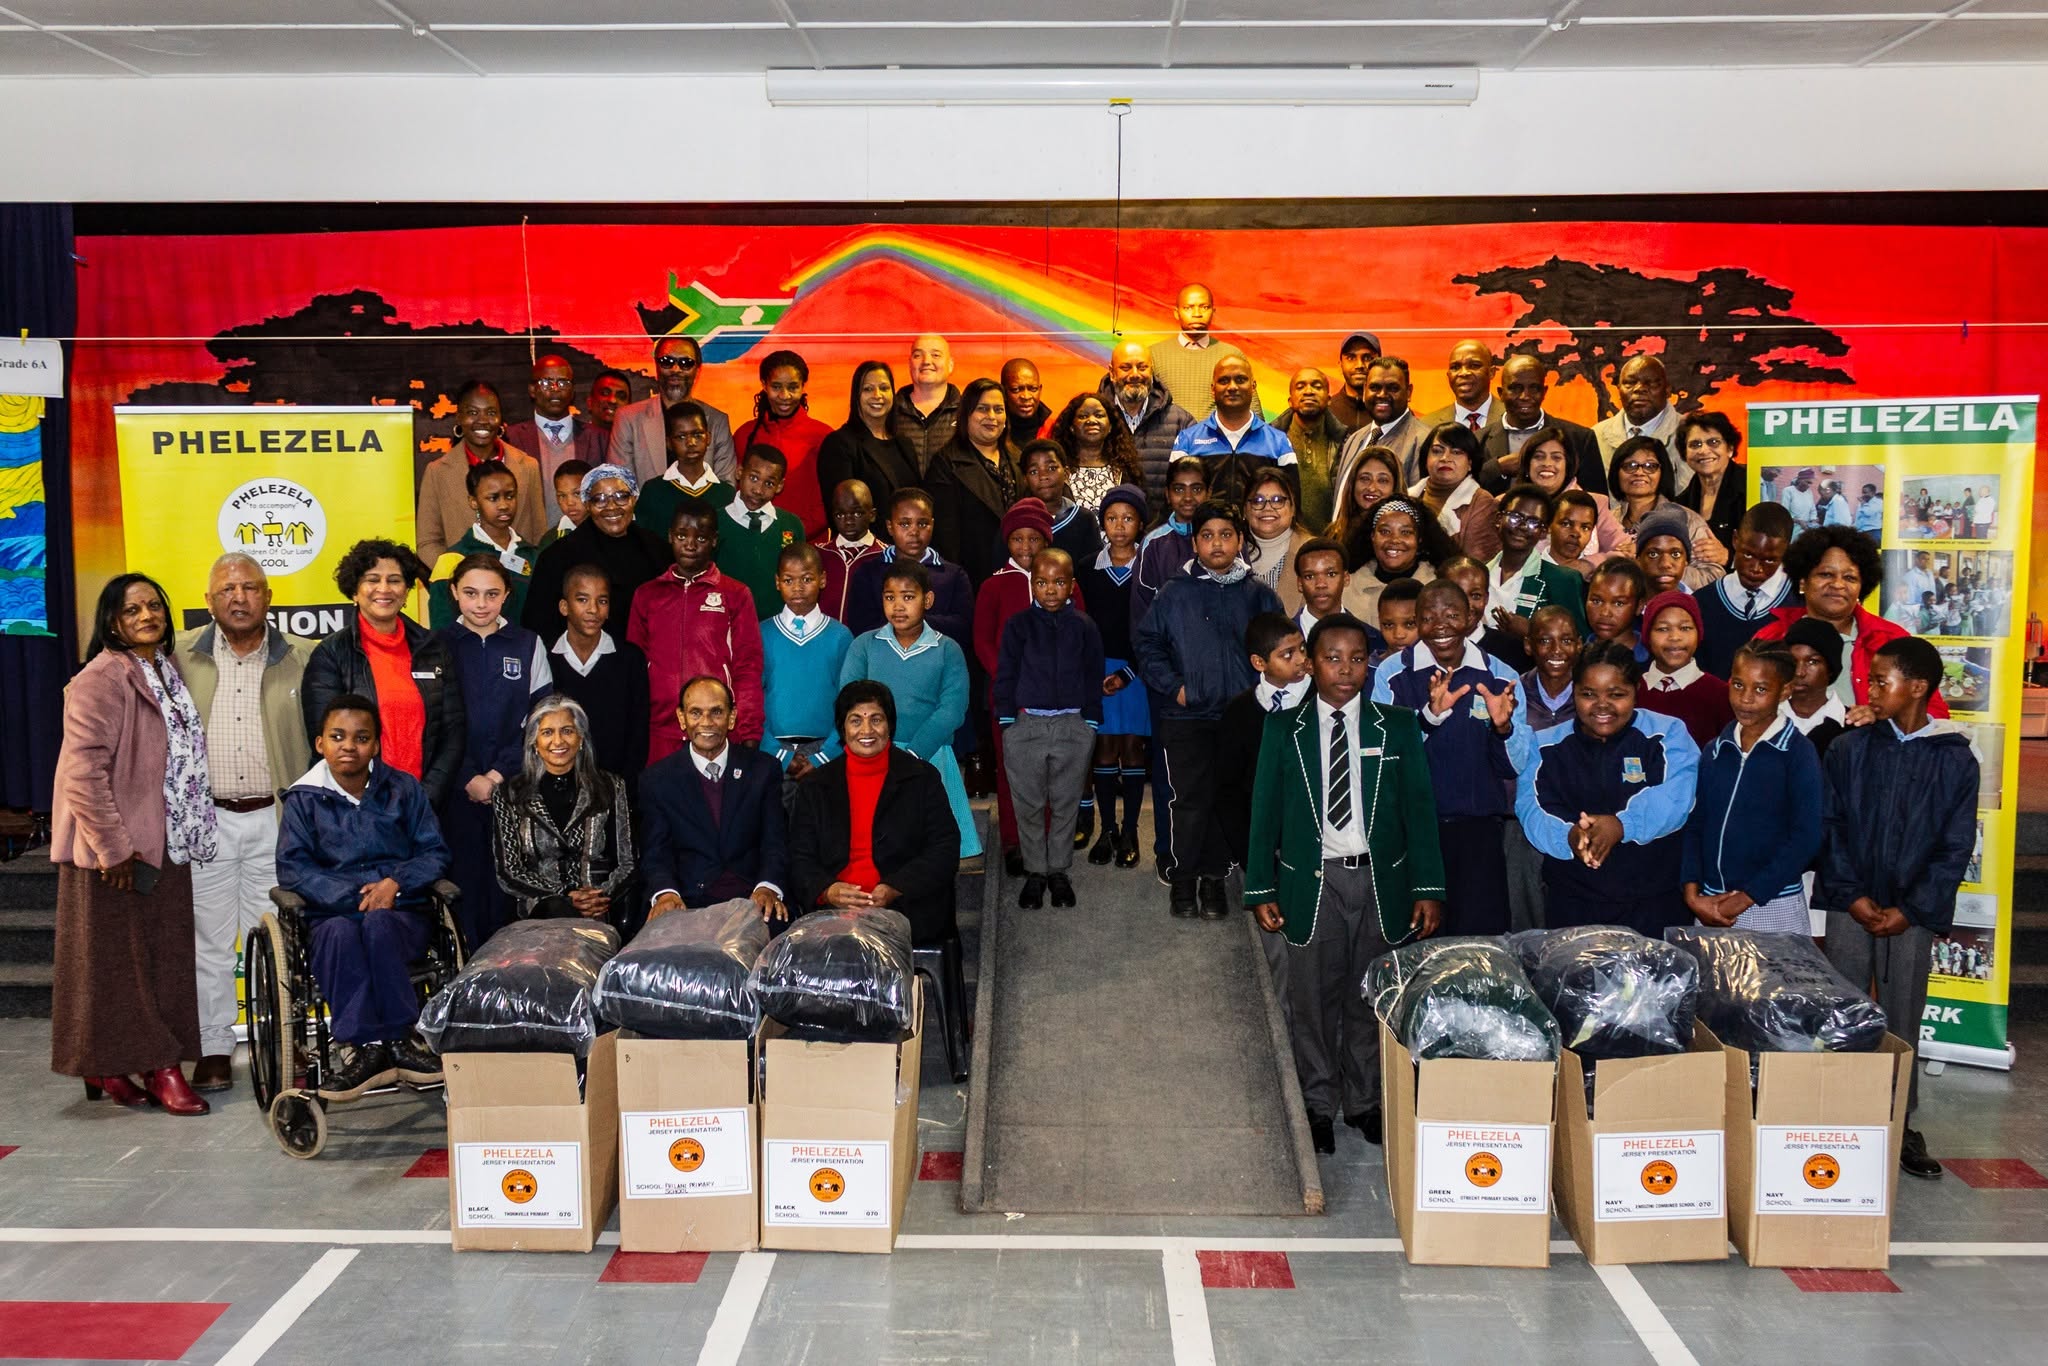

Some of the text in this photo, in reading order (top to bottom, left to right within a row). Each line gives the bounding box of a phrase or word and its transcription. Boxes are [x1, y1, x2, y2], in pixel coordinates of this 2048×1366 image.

[31, 360, 48, 369] 6A
[1764, 404, 2019, 435] PHELEZELA
[153, 430, 383, 454] PHELEZELA
[232, 484, 313, 510] PHELEZELA
[261, 559, 288, 567] COOL
[650, 1116, 720, 1128] PHELEZELA
[1448, 1130, 1520, 1141] PHELEZELA
[1786, 1132, 1858, 1142] PHELEZELA
[1624, 1138, 1695, 1149] PHELEZELA
[484, 1149, 553, 1158] PHELEZELA
[792, 1146, 861, 1157] PHELEZELA
